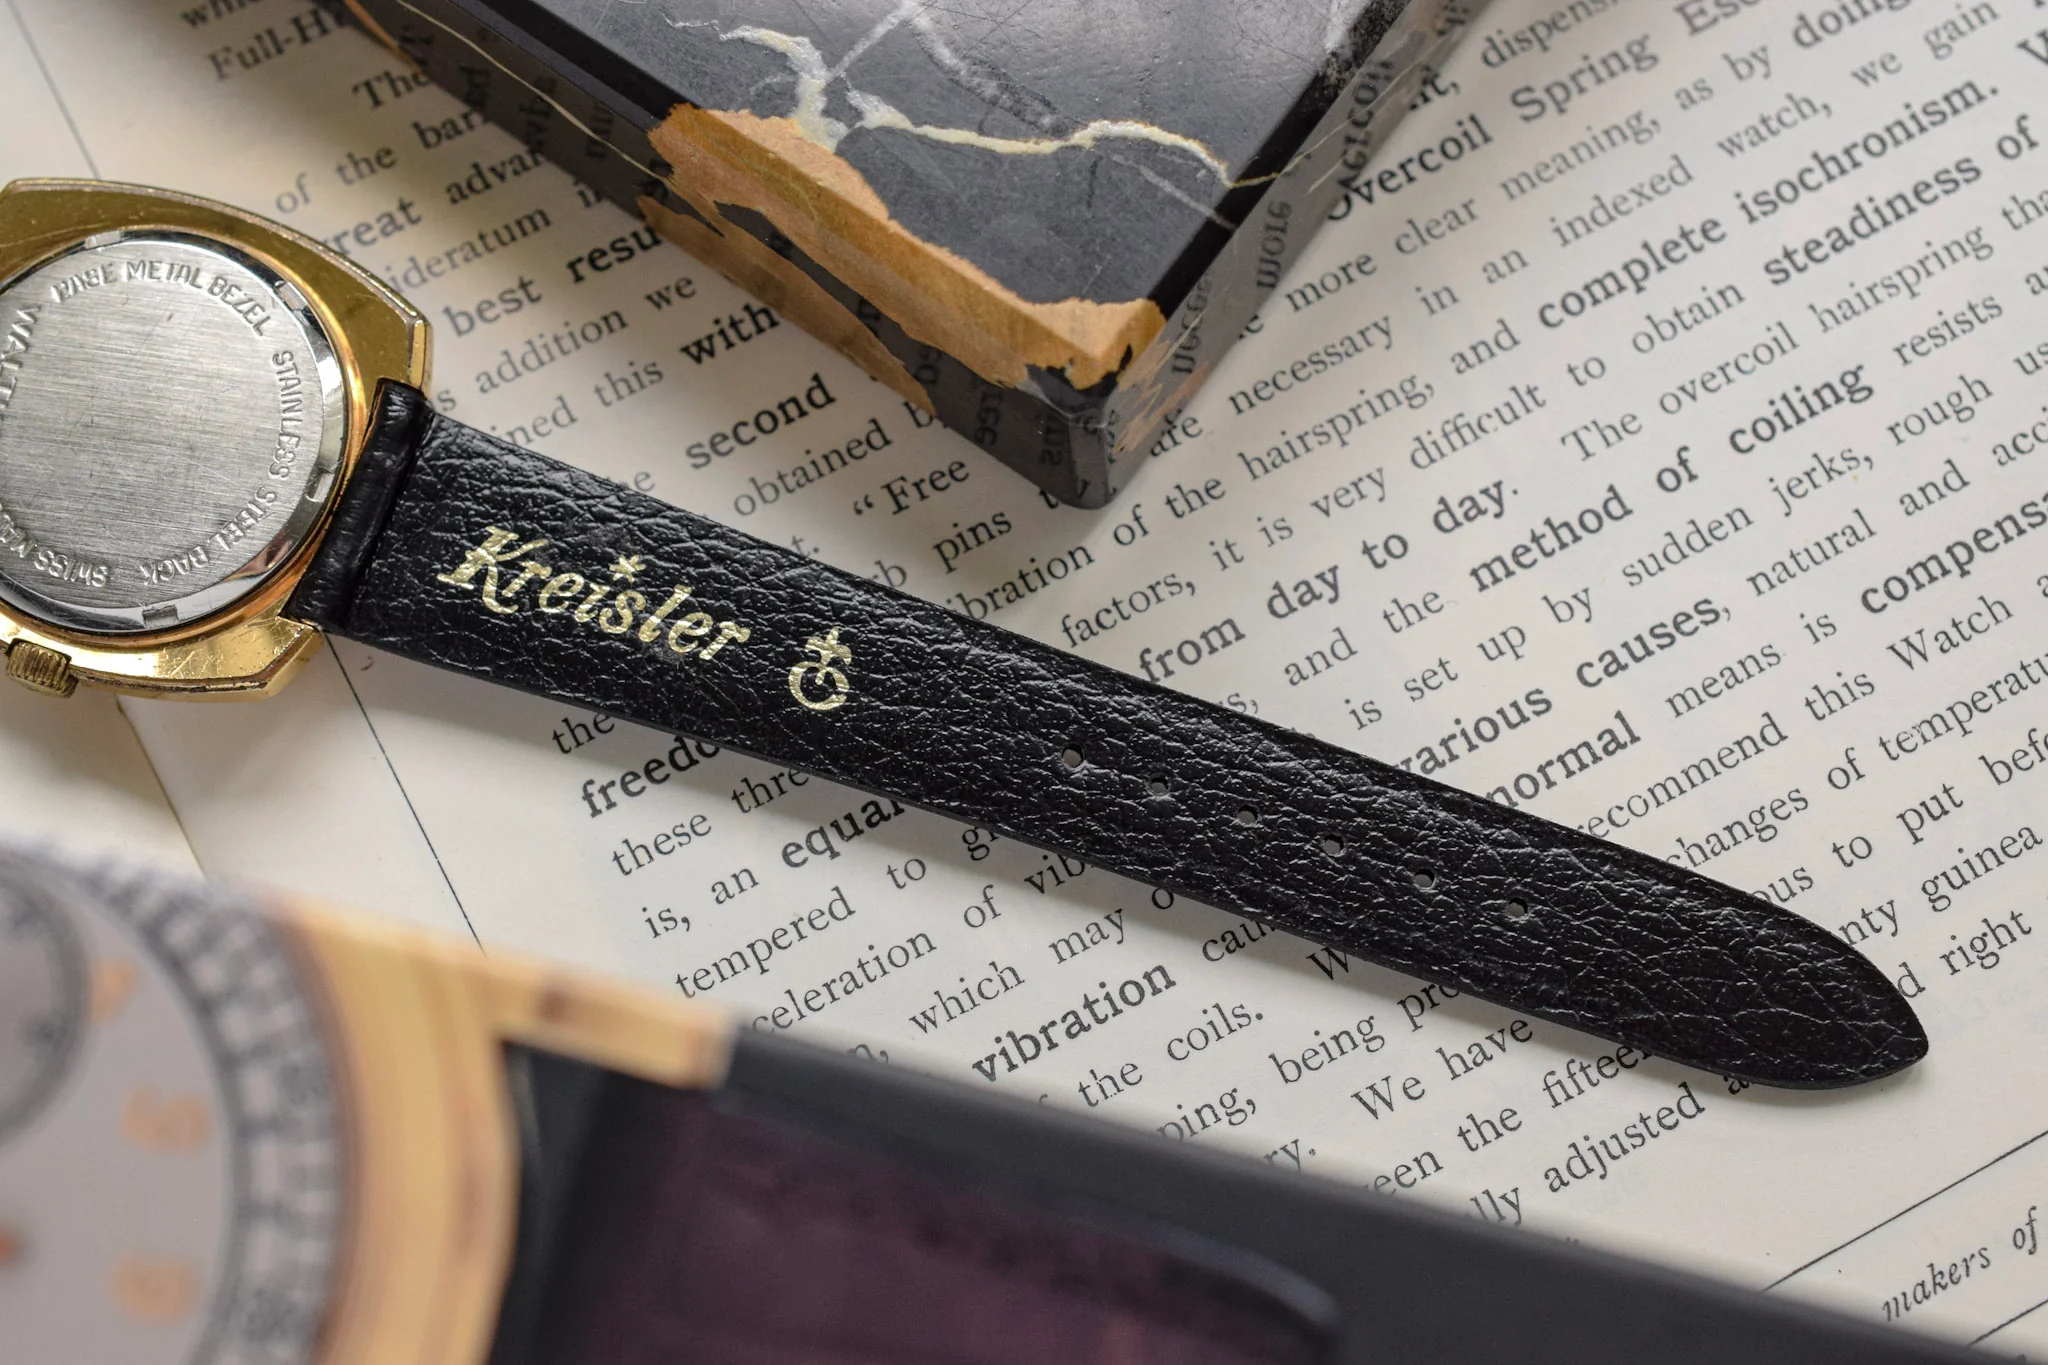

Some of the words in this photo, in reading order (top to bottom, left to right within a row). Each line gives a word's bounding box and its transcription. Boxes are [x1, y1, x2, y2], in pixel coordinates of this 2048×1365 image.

[1510, 35, 1658, 122] Spring
[277, 174, 309, 212] of
[335, 146, 398, 185] the
[322, 196, 423, 255] reat
[1285, 255, 1377, 312] more
[1394, 197, 1478, 255] clear
[1501, 112, 1659, 200] meaning,
[1676, 83, 1713, 109] as
[1722, 46, 1772, 82] by
[123, 259, 203, 290] METAL
[206, 275, 273, 338] BEZEL
[384, 207, 553, 293] ideratum
[442, 275, 543, 338] best
[565, 225, 664, 285] resu
[932, 512, 1012, 574] pins
[1228, 316, 1392, 415] necessary
[1416, 287, 1458, 315] in
[1482, 251, 1528, 284] an
[1550, 154, 1693, 246] indexed
[1718, 94, 1831, 157] watch,
[1852, 54, 1901, 86] we
[1925, 3, 1998, 59] gain
[1113, 503, 1149, 546] of
[1165, 479, 1226, 519] the
[1237, 376, 1433, 480] hairspring,
[1451, 319, 1520, 374] and
[1538, 219, 1726, 328] complete
[1735, 81, 1998, 224] isochronism.
[475, 309, 629, 394] addition
[644, 277, 696, 311] we
[595, 361, 663, 407] this
[679, 302, 782, 366] with
[269, 350, 304, 480] STAINLESS
[686, 372, 837, 469] second
[733, 417, 894, 517] obtained
[207, 485, 278, 552] STEEL
[612, 815, 712, 876] these
[1061, 573, 1196, 648] factors,
[1209, 540, 1244, 571] it
[1257, 517, 1293, 547] is
[1311, 468, 1385, 517] very
[1410, 385, 1546, 469] difficult
[1567, 357, 1606, 386] to
[1632, 285, 1744, 353] obtain
[1764, 158, 1982, 286] steadiness
[1996, 114, 2039, 160] of
[138, 545, 210, 586] BACK
[436, 525, 751, 661] Kreisler
[642, 906, 693, 939] is,
[711, 868, 759, 905] an
[1139, 617, 1247, 684] from
[1267, 565, 1339, 619] day
[1361, 534, 1409, 569] to
[1433, 480, 1518, 534] day.
[1560, 414, 1642, 461] The
[1659, 321, 1798, 414] overcoil
[1808, 227, 1993, 332] hairspring
[676, 886, 856, 998] tempered
[887, 858, 926, 889] to
[1284, 627, 1358, 686] and
[1383, 592, 1444, 633] the
[1469, 484, 1633, 592] method
[1656, 445, 1699, 493] of
[1729, 364, 1874, 454] coiling
[1893, 296, 2002, 366] resists
[751, 932, 938, 1034] celeration
[963, 884, 1001, 928] of
[1024, 854, 1093, 895] vib
[1344, 699, 1382, 730] is
[1404, 658, 1458, 702] set
[1477, 626, 1526, 661] up
[1542, 588, 1592, 623] by
[1622, 507, 1753, 587] sudden
[1769, 448, 1873, 517] jerks,
[1887, 375, 1993, 445] rough
[909, 961, 1025, 1033] which
[1049, 908, 1124, 964] may
[1576, 598, 1730, 688] causes,
[1746, 508, 1876, 596] natural
[1899, 458, 1970, 516] and
[972, 965, 1177, 1082] vibration
[1665, 644, 1781, 718] means
[1800, 613, 1837, 644] is
[1860, 492, 2048, 615] compens
[1078, 1063, 1143, 1107] the
[1167, 1003, 1263, 1061] coils.
[1805, 671, 1875, 721] this
[1886, 595, 2013, 670] Watch
[1268, 1015, 1385, 1084] being
[1827, 747, 1866, 790] of
[1350, 1075, 1425, 1120] We
[1435, 1020, 1533, 1081] have
[1832, 836, 1873, 868] to
[1896, 783, 1964, 845] put
[1978, 727, 2048, 785] bef
[1457, 1108, 1522, 1152] the
[1837, 899, 1899, 946] nty
[1921, 827, 2043, 913] guinea
[1544, 1081, 1706, 1193] adjusted
[1939, 911, 2032, 976] right
[1883, 1247, 1991, 1321] makers
[2012, 1205, 2038, 1256] of
